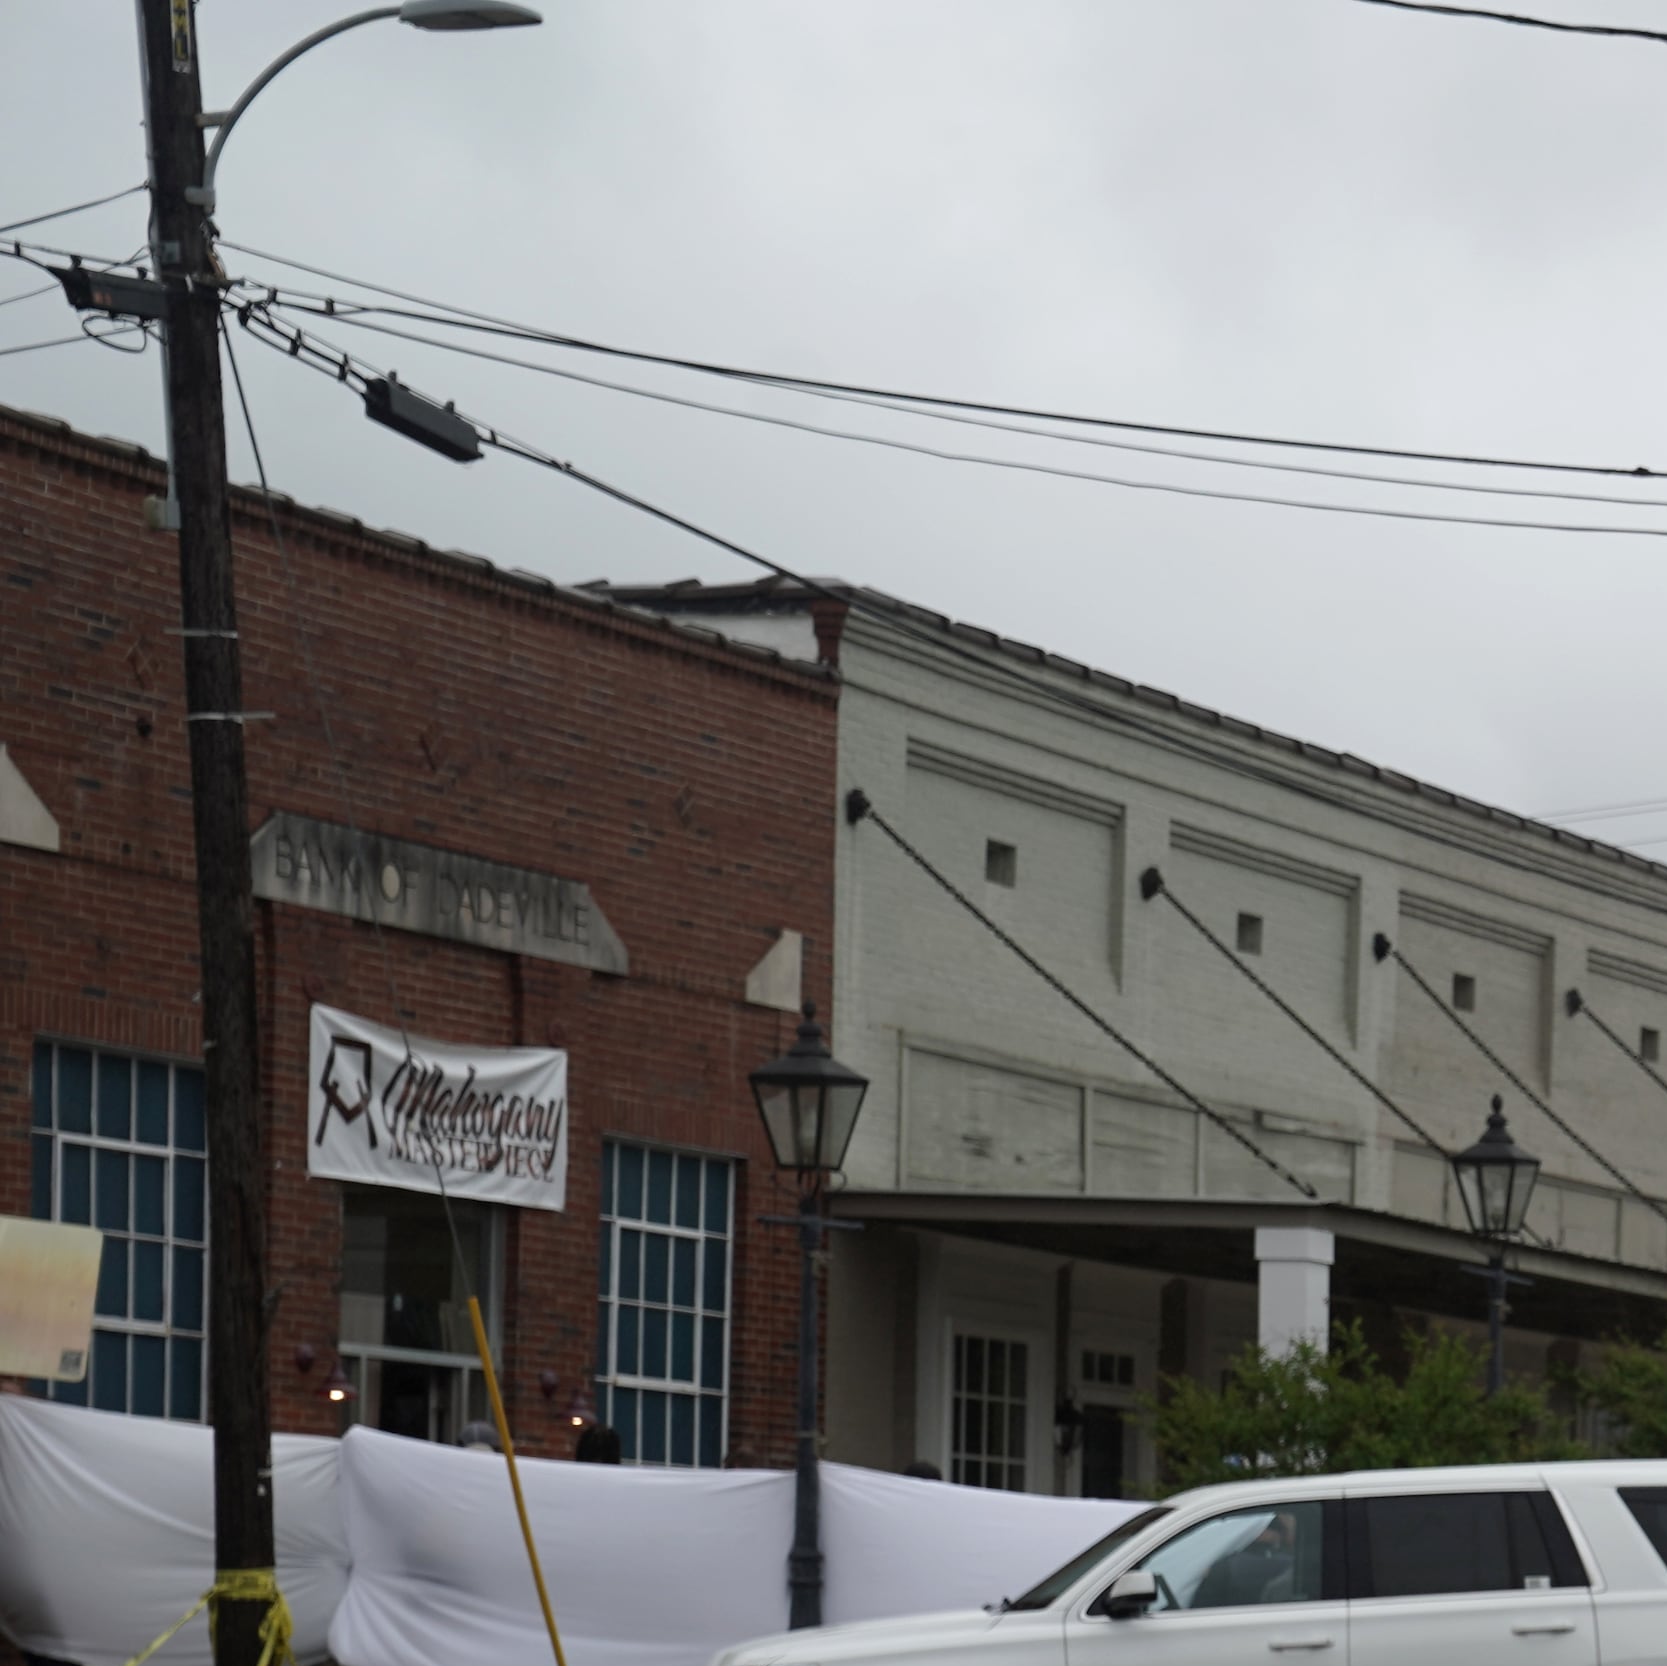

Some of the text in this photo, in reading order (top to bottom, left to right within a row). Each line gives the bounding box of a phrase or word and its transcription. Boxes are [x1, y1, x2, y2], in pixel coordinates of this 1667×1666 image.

[276, 834, 590, 946] BANK OF DADEVILLE
[382, 1060, 563, 1172] Mahogany
